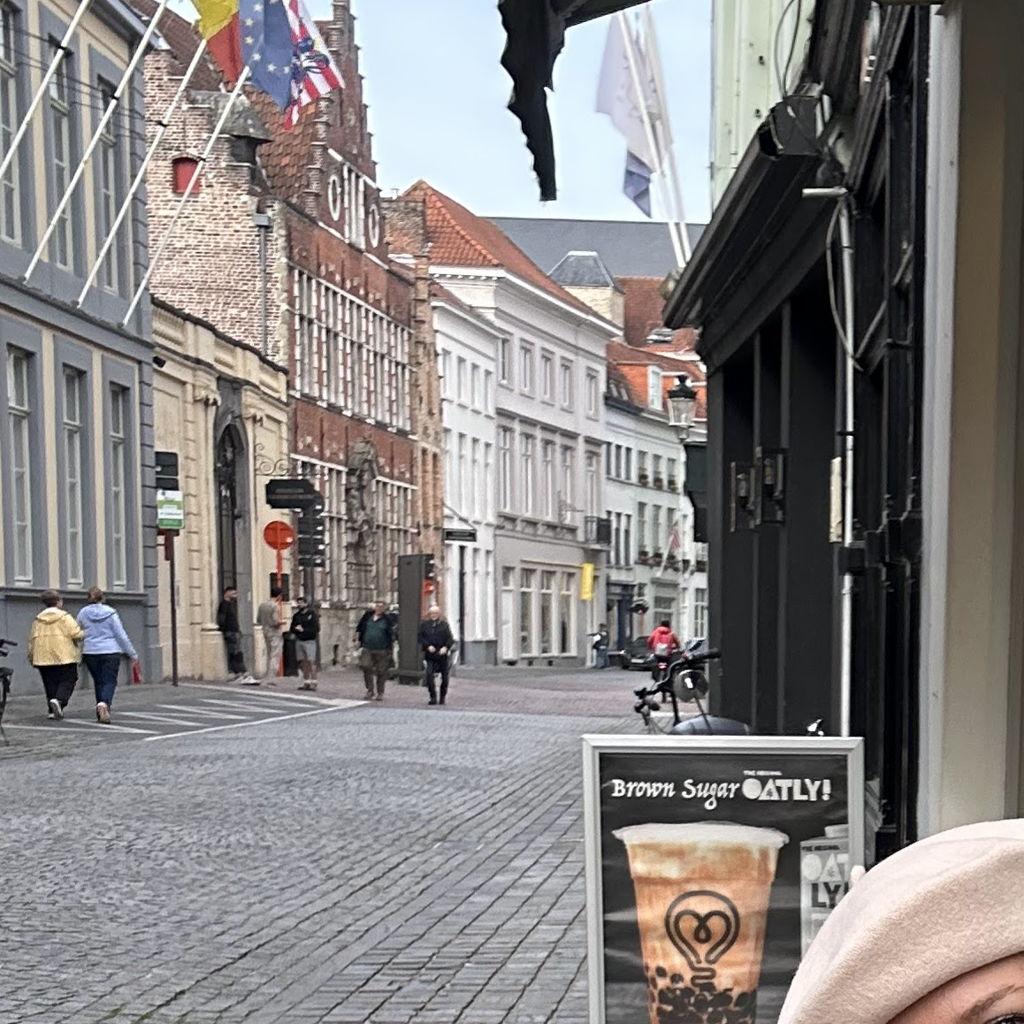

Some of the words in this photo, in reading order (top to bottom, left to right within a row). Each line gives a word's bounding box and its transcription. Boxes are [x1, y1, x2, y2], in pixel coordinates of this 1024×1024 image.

[611, 779, 675, 797] Brown
[681, 779, 740, 810] Sugar
[742, 778, 831, 800] OATLY!
